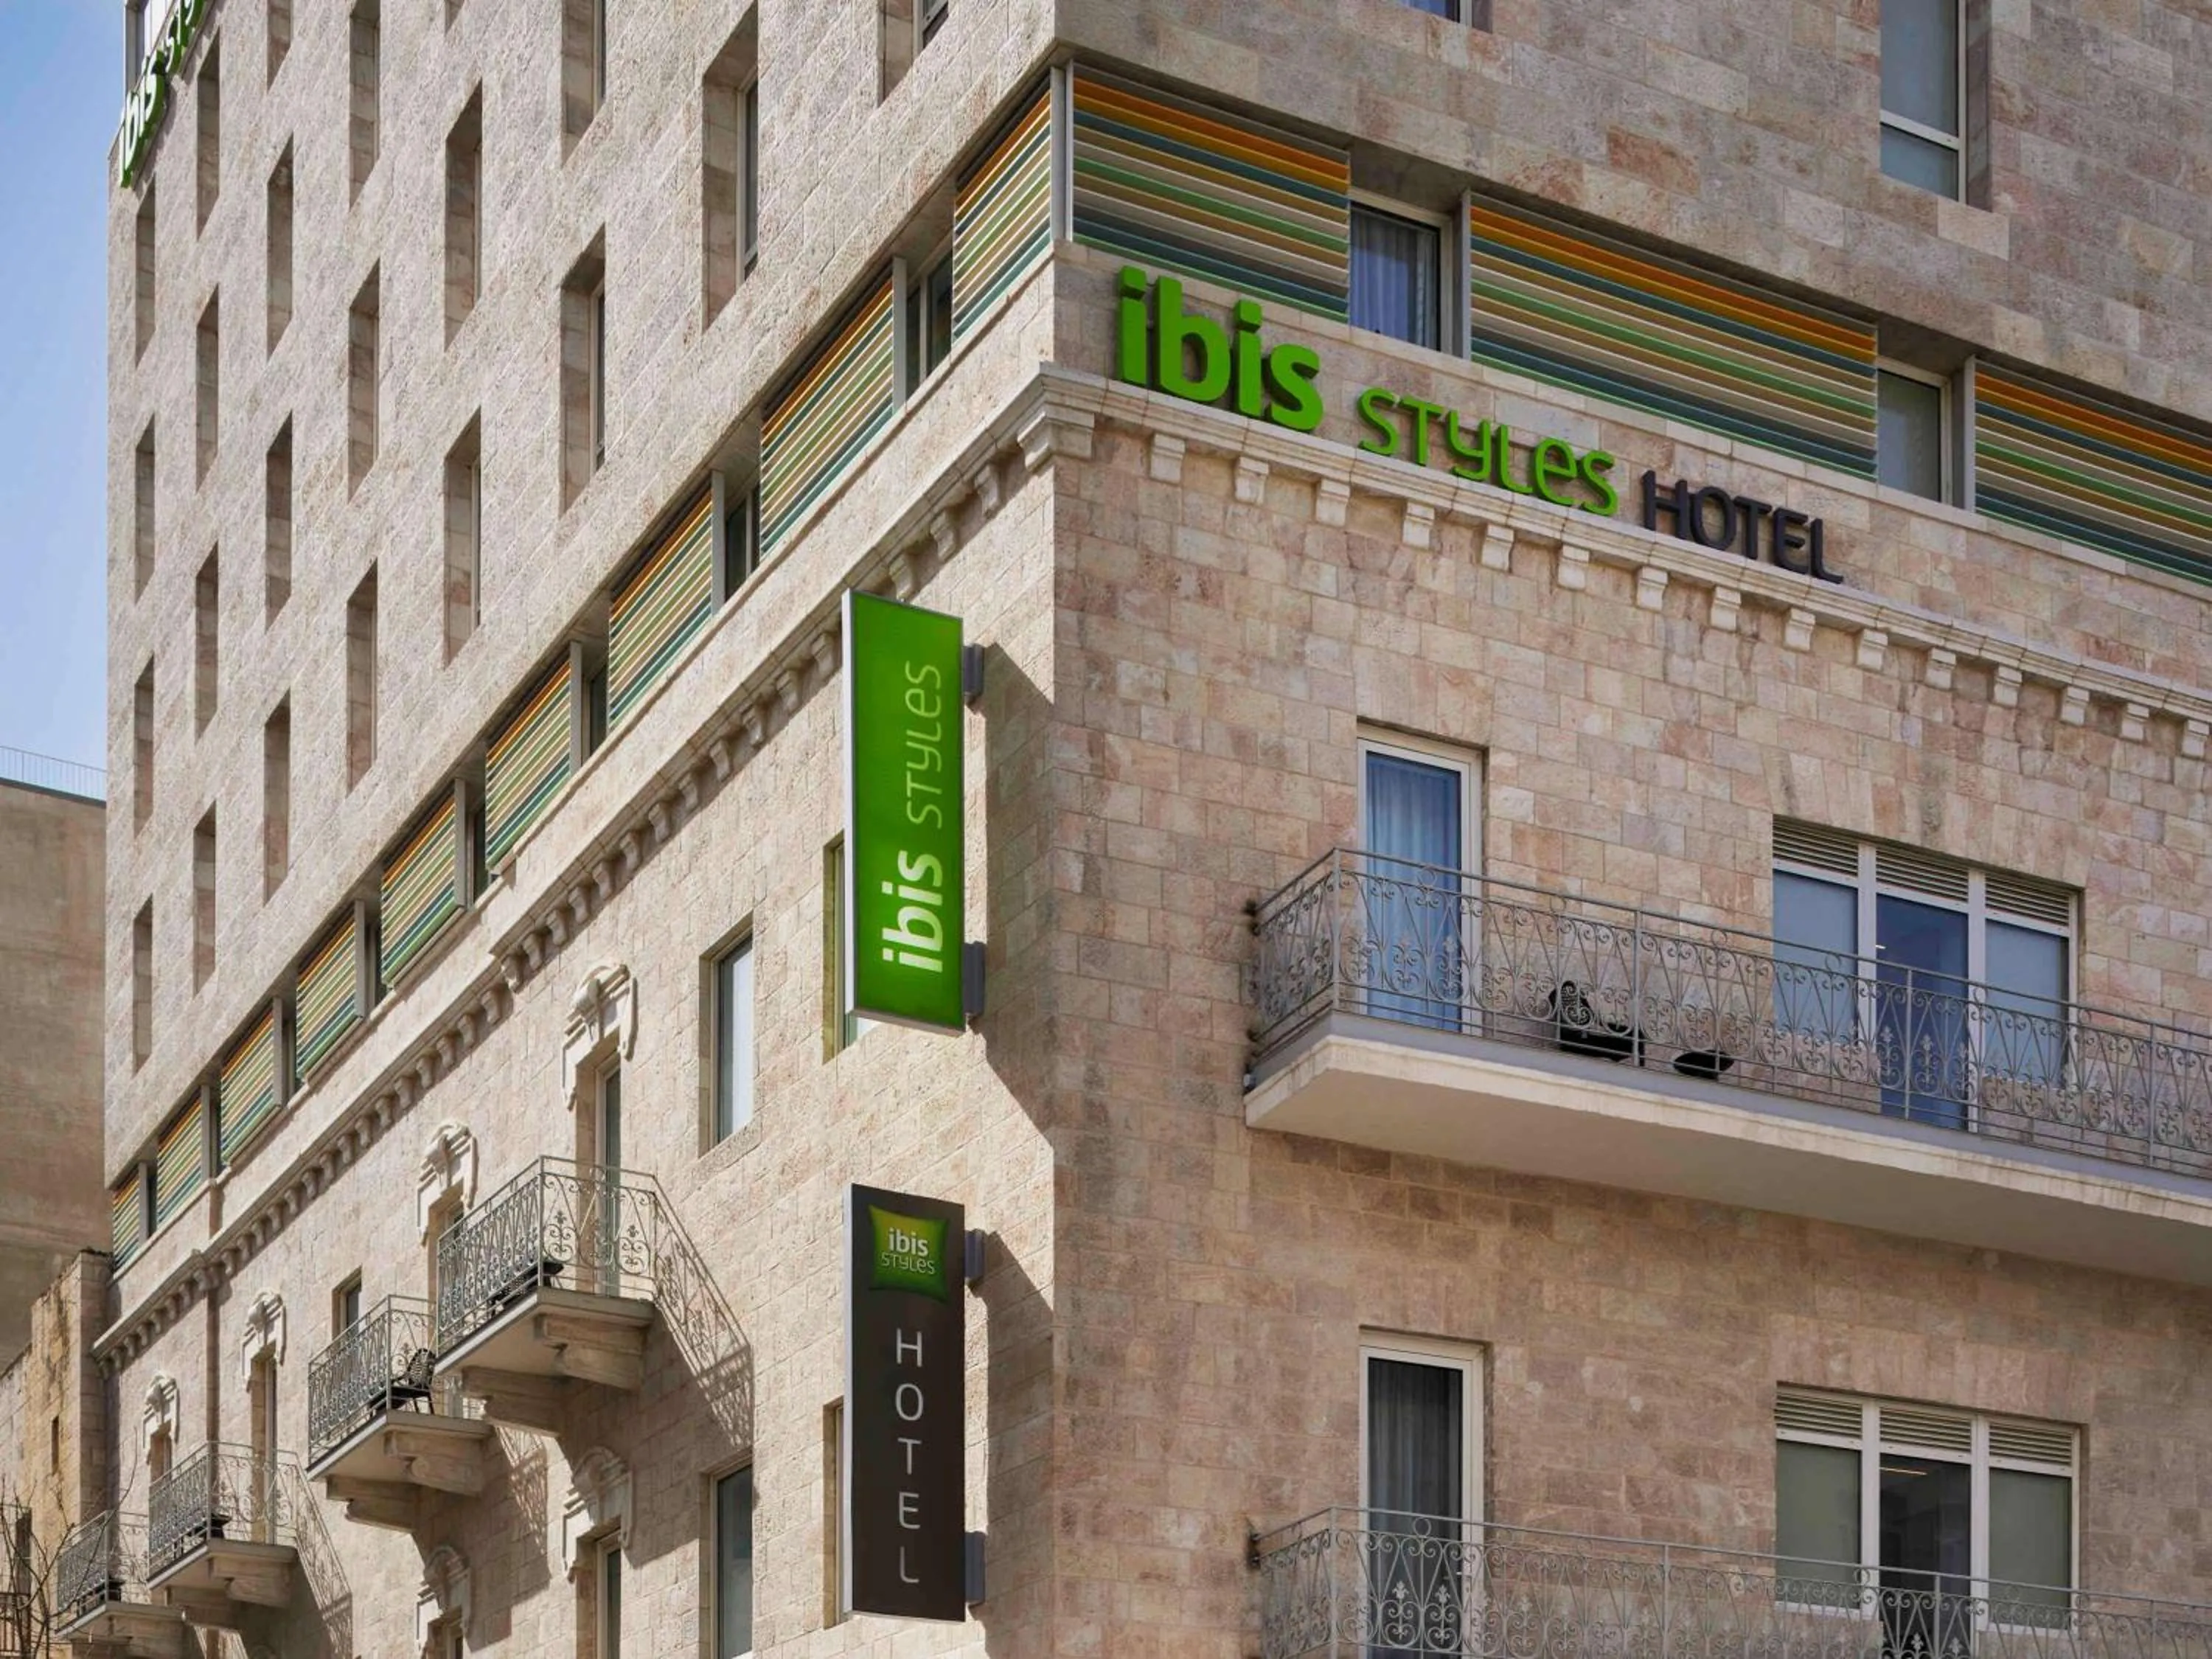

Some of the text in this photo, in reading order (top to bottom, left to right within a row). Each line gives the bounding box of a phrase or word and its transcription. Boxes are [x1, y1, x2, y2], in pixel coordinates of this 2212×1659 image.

[119, 49, 164, 187] ibis
[1117, 264, 1324, 434] ibis
[1641, 469, 1843, 584] HOTEL
[881, 849, 943, 973] ibis
[888, 1227, 928, 1256] ibis
[895, 1328, 924, 1584] HOTEL
